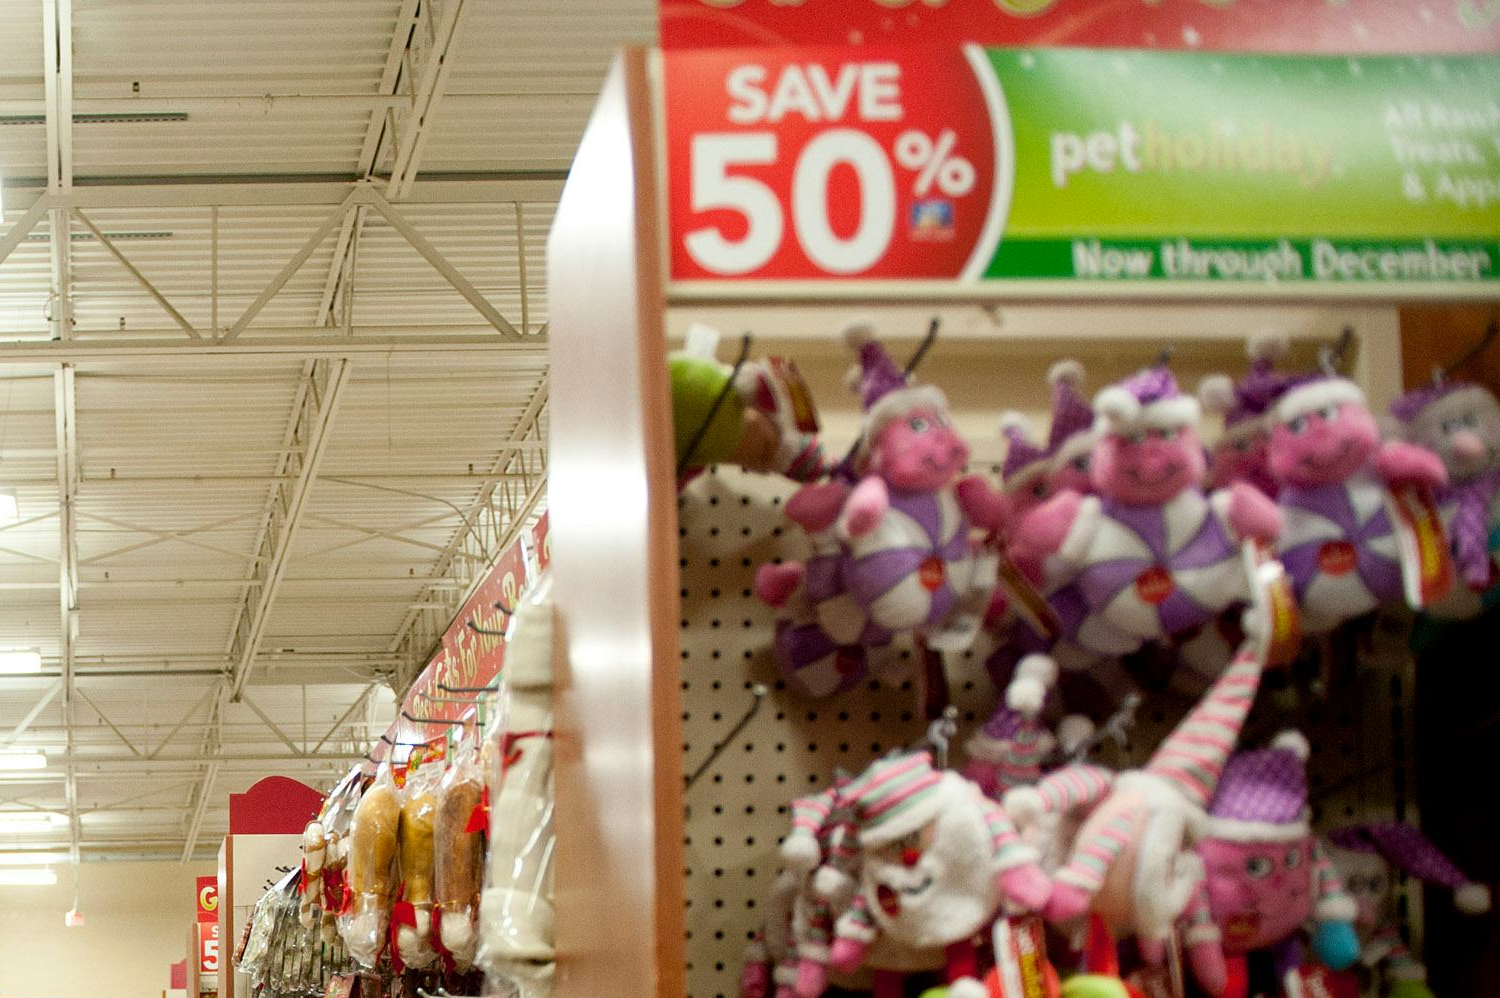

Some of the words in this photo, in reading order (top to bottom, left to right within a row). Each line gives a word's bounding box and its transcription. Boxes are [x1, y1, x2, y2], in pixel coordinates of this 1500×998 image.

[726, 62, 904, 123] SAVE
[683, 129, 976, 277] 50%
[1072, 239, 1154, 277] Now
[1161, 236, 1302, 284] through
[1312, 236, 1492, 281] December
